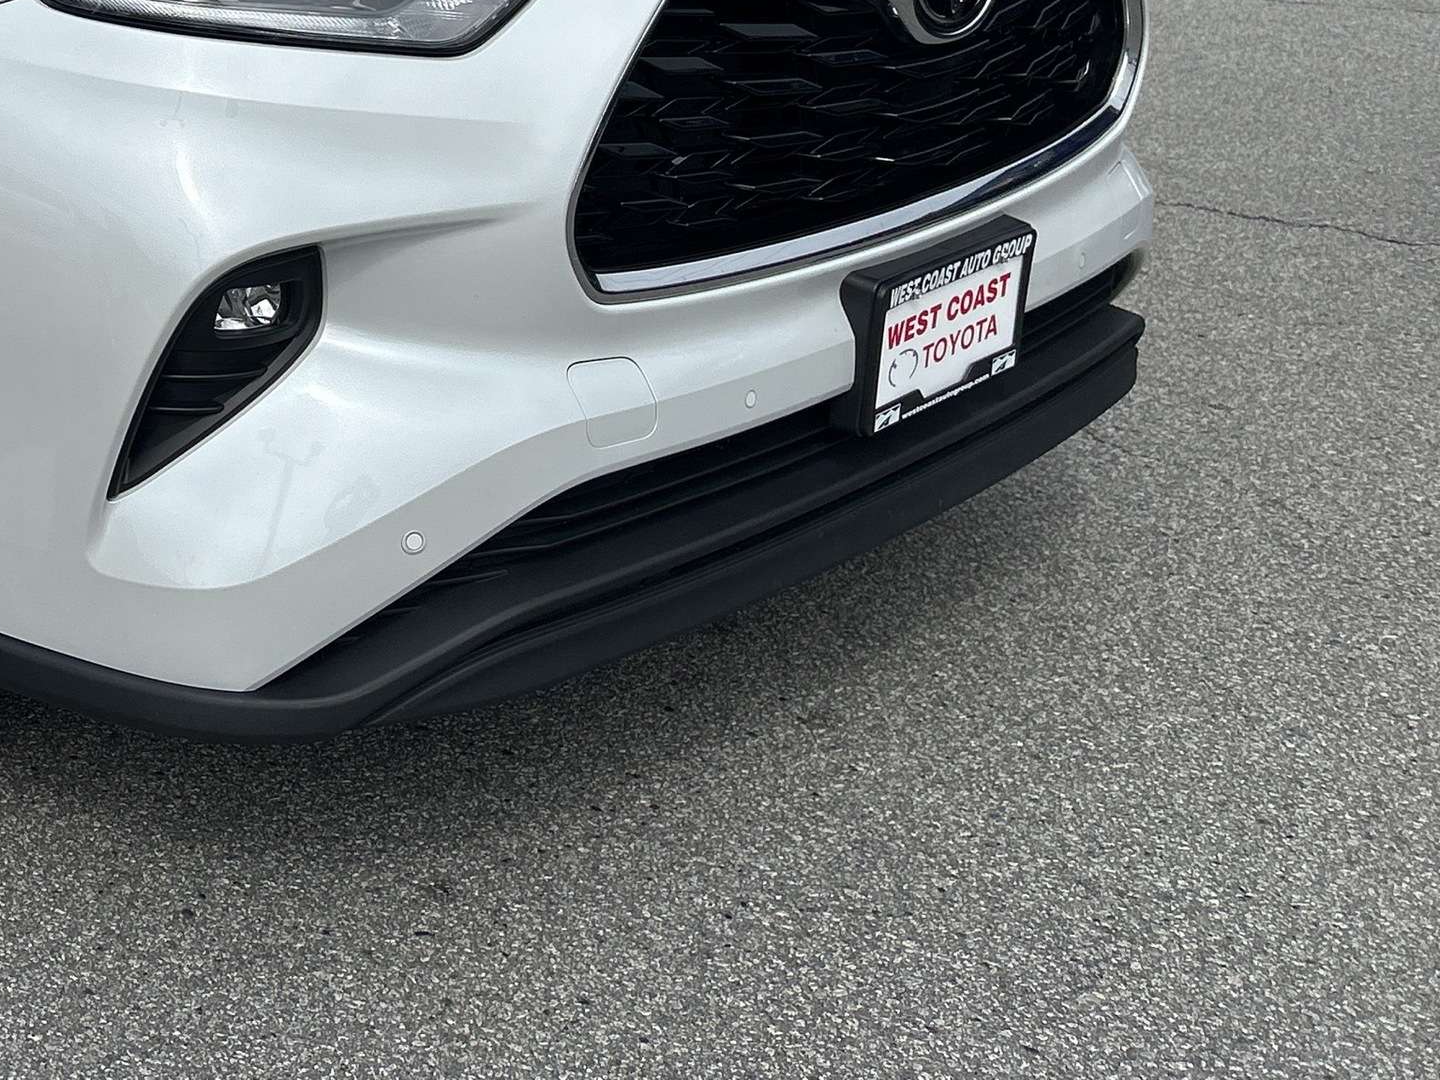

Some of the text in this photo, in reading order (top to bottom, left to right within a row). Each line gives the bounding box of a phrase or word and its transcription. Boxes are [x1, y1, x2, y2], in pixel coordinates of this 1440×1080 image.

[890, 234, 1033, 308] WEST COAST AUTO GROUP
[888, 272, 1012, 350] WEST COAST
[922, 314, 998, 369] TOYOTA
